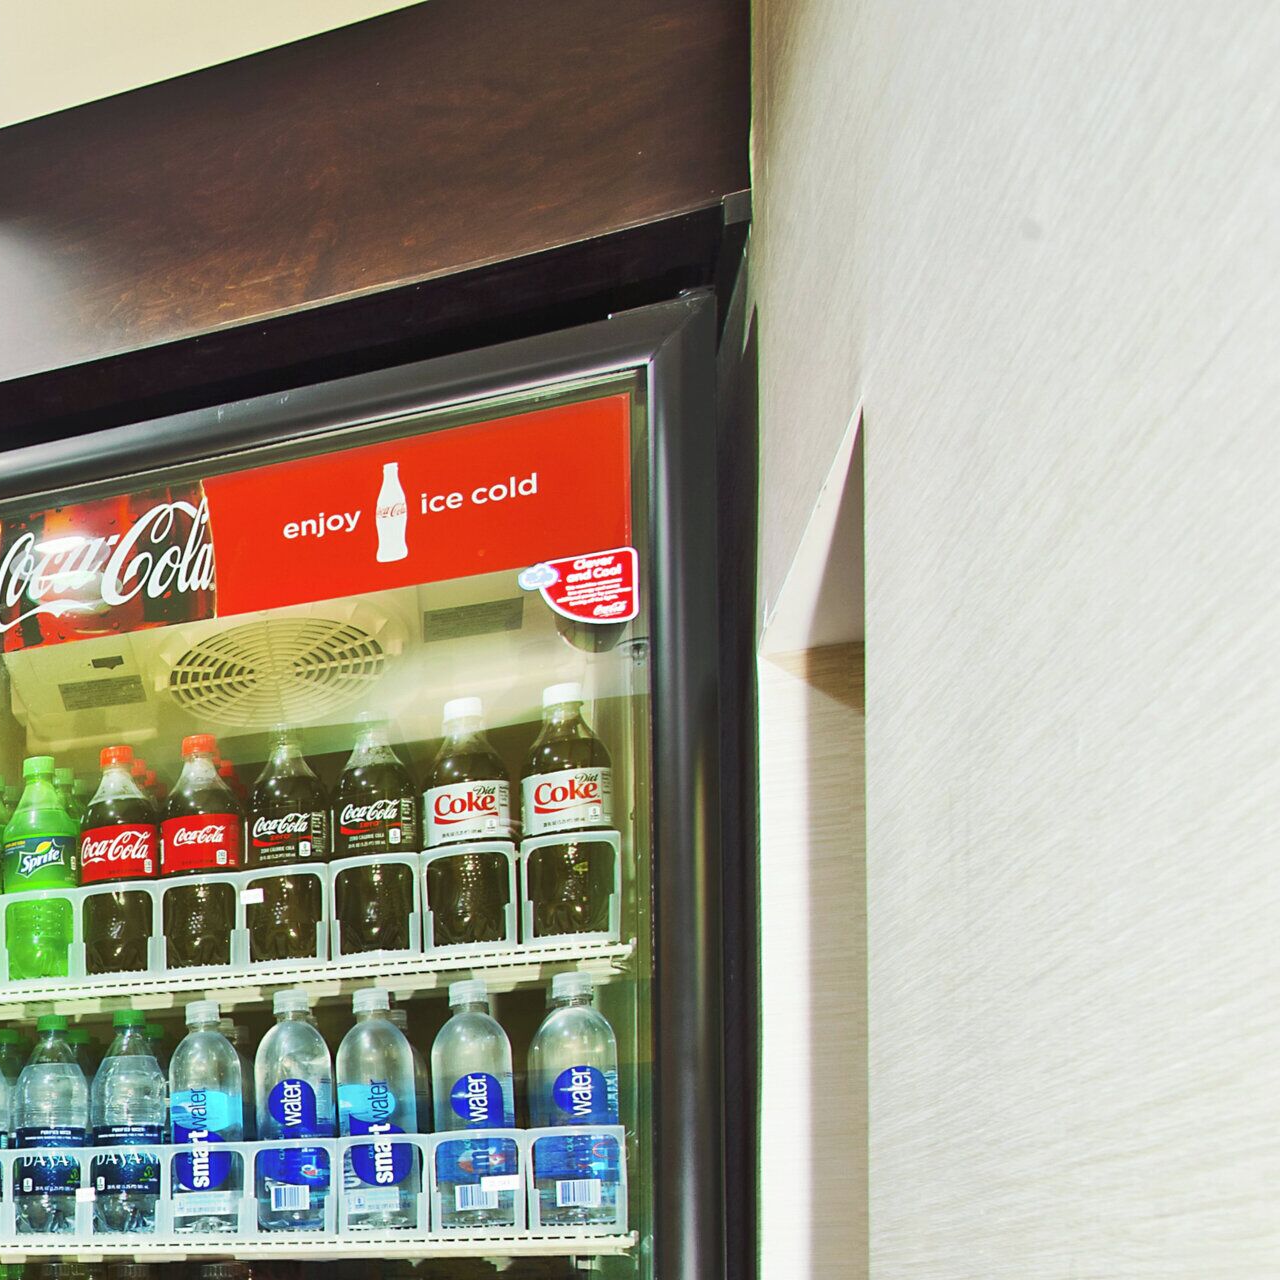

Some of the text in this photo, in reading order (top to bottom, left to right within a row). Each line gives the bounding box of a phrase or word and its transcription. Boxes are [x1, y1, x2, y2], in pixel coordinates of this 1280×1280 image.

[420, 472, 538, 516] ice cold
[282, 507, 361, 540] enjoy
[566, 563, 623, 583] and Cool
[574, 771, 599, 785] Diet
[473, 784, 496, 799] Diet
[533, 779, 599, 807] Coke
[340, 799, 400, 826] Coca-Cola
[434, 793, 496, 818] Coke
[173, 825, 226, 847] Coca-Cola
[252, 812, 310, 835] Coca-Cola
[21, 848, 61, 873] Sprite
[81, 830, 151, 867] Coca-Cola
